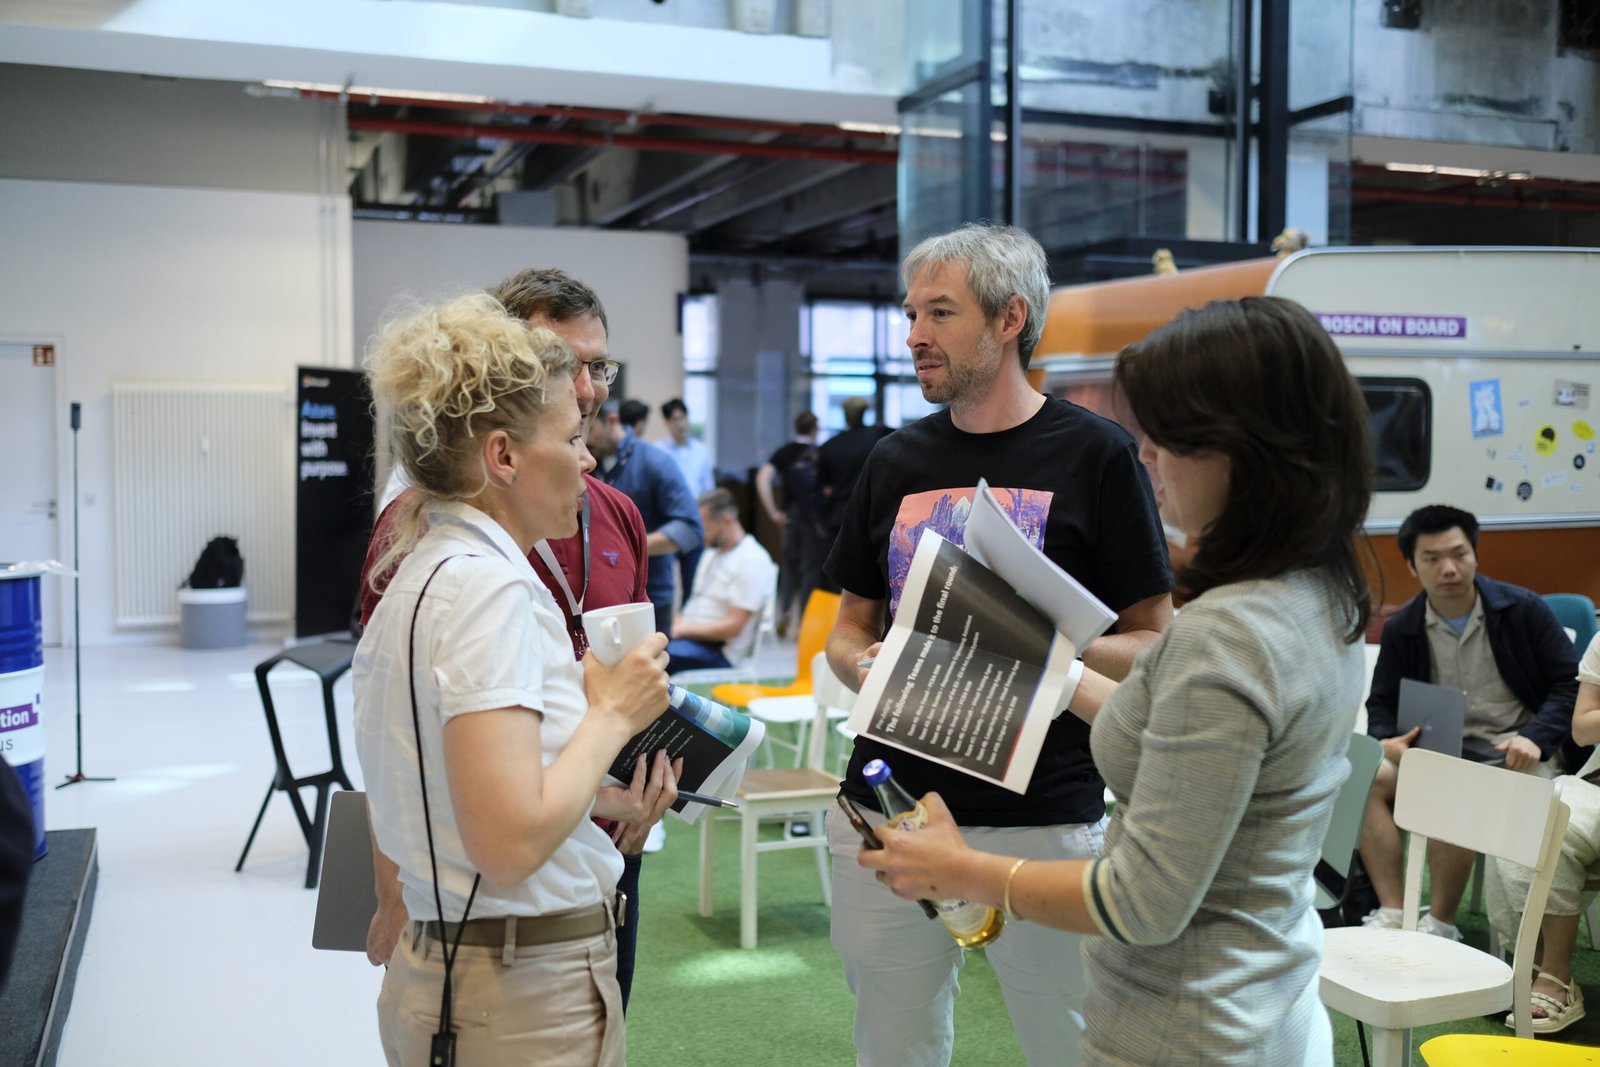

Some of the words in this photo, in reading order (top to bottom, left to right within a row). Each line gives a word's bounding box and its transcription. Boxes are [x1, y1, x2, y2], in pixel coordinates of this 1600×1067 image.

[1321, 316, 1375, 334] BOSCH
[1378, 317, 1402, 335] ON
[1405, 318, 1459, 336] BOARD
[944, 565, 958, 589] round:
[936, 590, 949, 608] final
[933, 610, 943, 623] the
[930, 624, 938, 633] to
[920, 637, 933, 658] made
[908, 659, 922, 683] Teams
[892, 678, 915, 716] following
[885, 717, 898, 732] The
